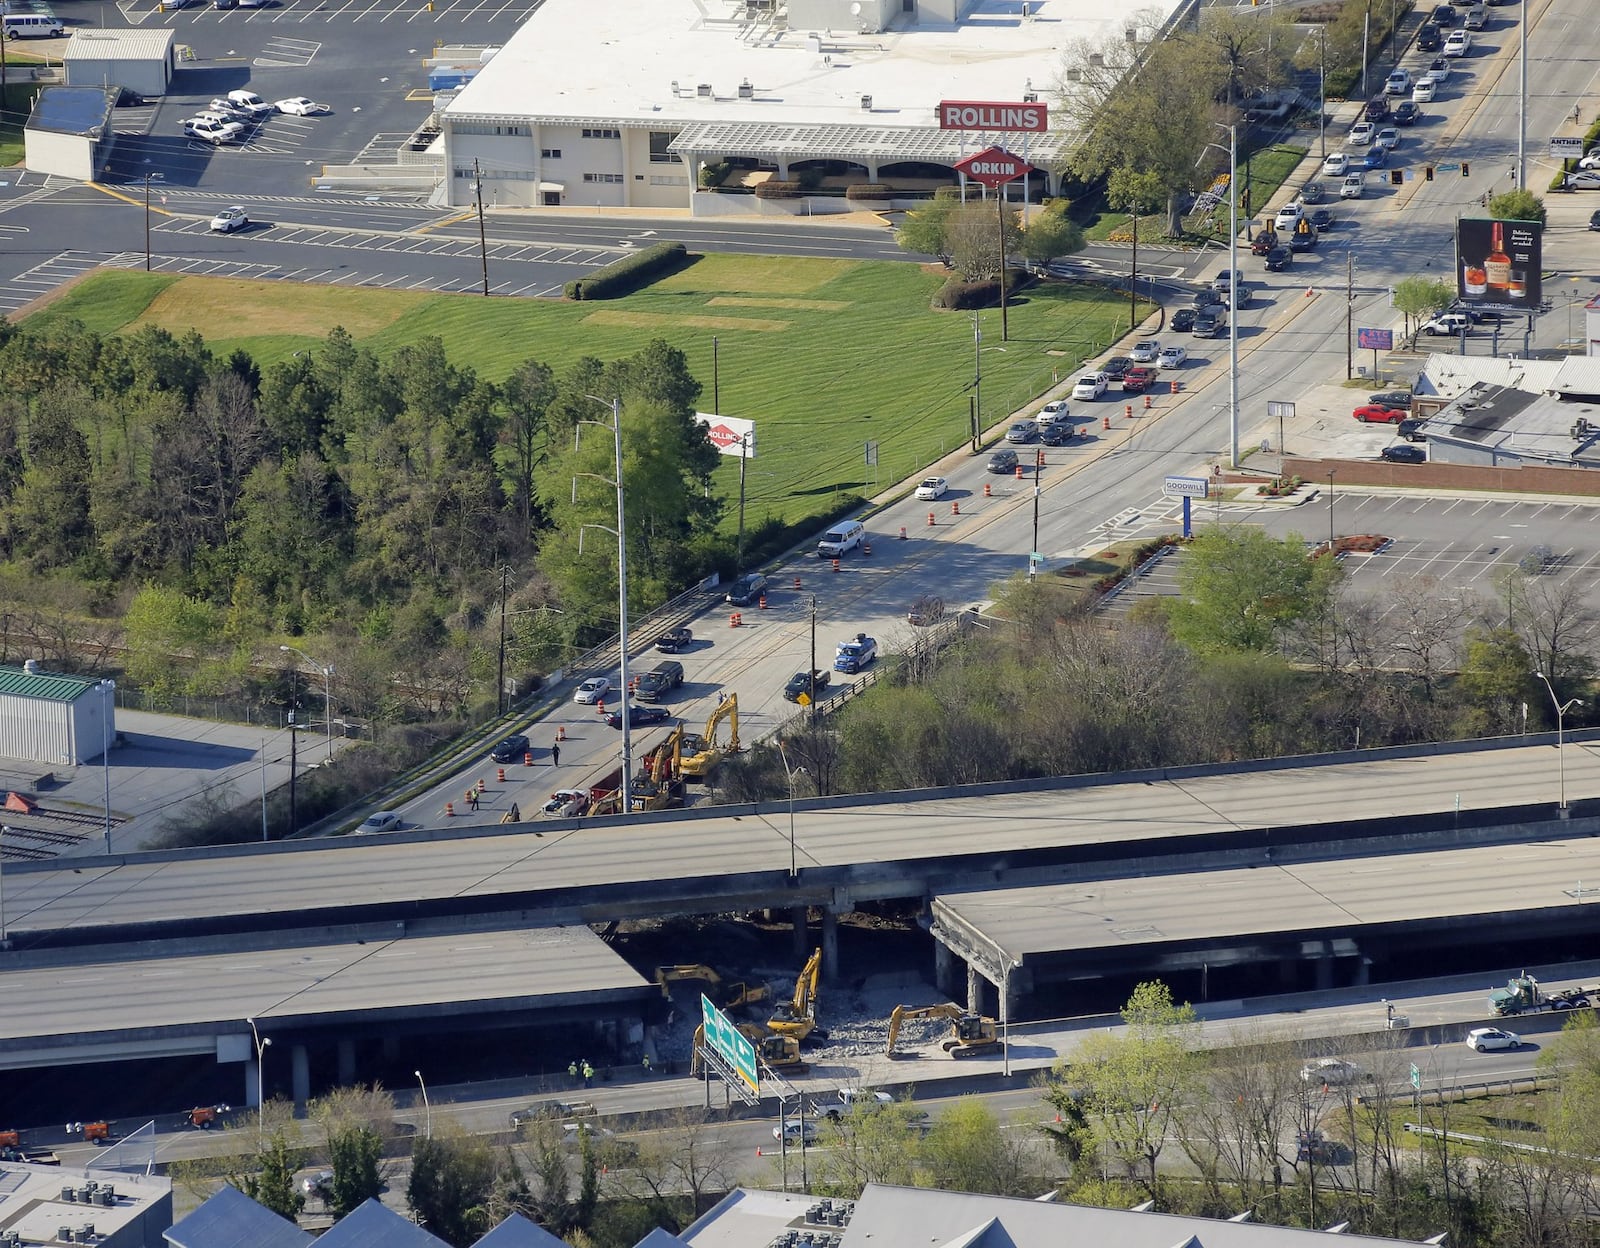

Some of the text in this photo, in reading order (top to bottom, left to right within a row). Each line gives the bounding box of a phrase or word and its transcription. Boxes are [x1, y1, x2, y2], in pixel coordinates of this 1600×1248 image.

[946, 107, 1039, 128] ROLLINS
[971, 162, 1015, 175] ORKIN
[1166, 482, 1204, 491] GOODWILL
